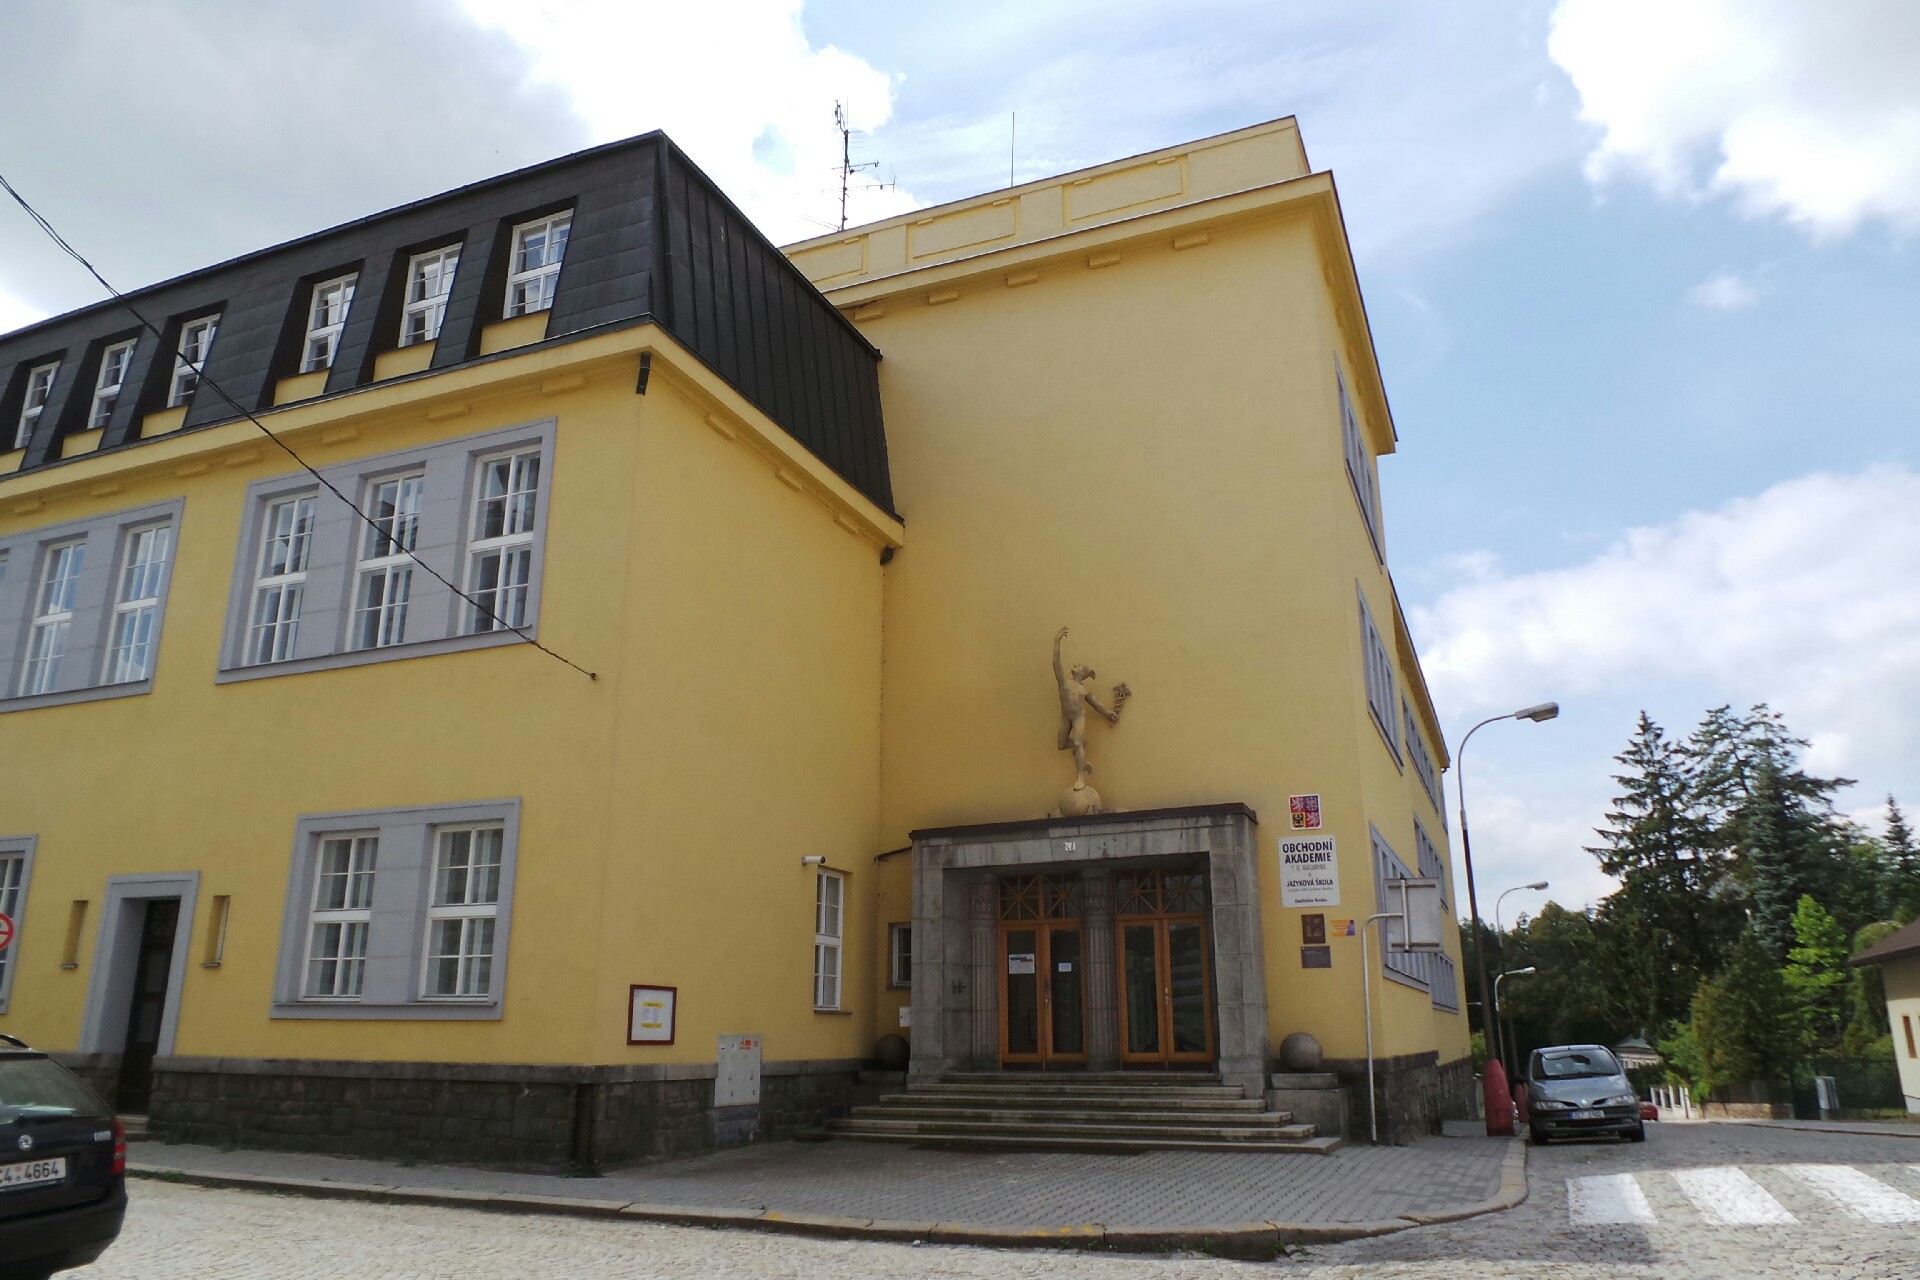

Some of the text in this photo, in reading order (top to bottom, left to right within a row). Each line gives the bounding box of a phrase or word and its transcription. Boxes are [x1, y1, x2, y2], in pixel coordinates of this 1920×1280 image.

[1283, 838, 1333, 853] OBCHODNÍ
[1285, 852, 1331, 863] AKADEMIE
[1287, 878, 1333, 887] JAZYKOVÁ ŠKOLA
[25, 1160, 59, 1180] 4664
